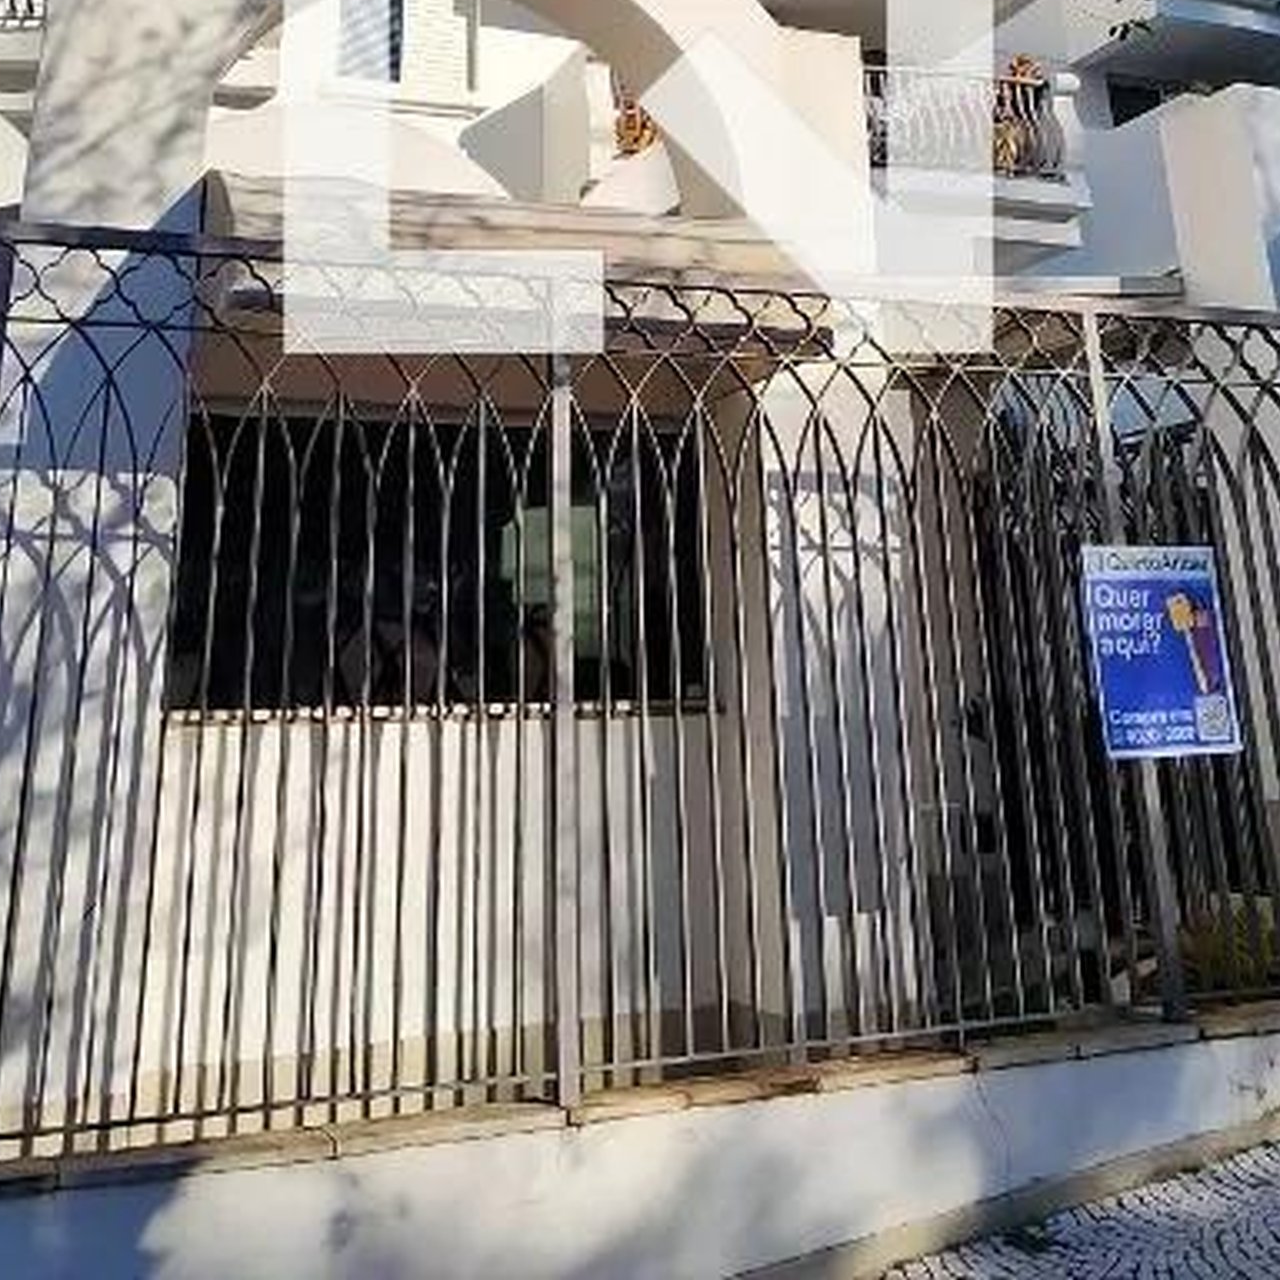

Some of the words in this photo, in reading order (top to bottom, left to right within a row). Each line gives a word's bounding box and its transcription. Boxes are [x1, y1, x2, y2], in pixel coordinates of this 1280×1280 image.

[1094, 584, 1151, 608] Quer
[1097, 612, 1163, 632] morar
[1099, 632, 1161, 661] aqui?
